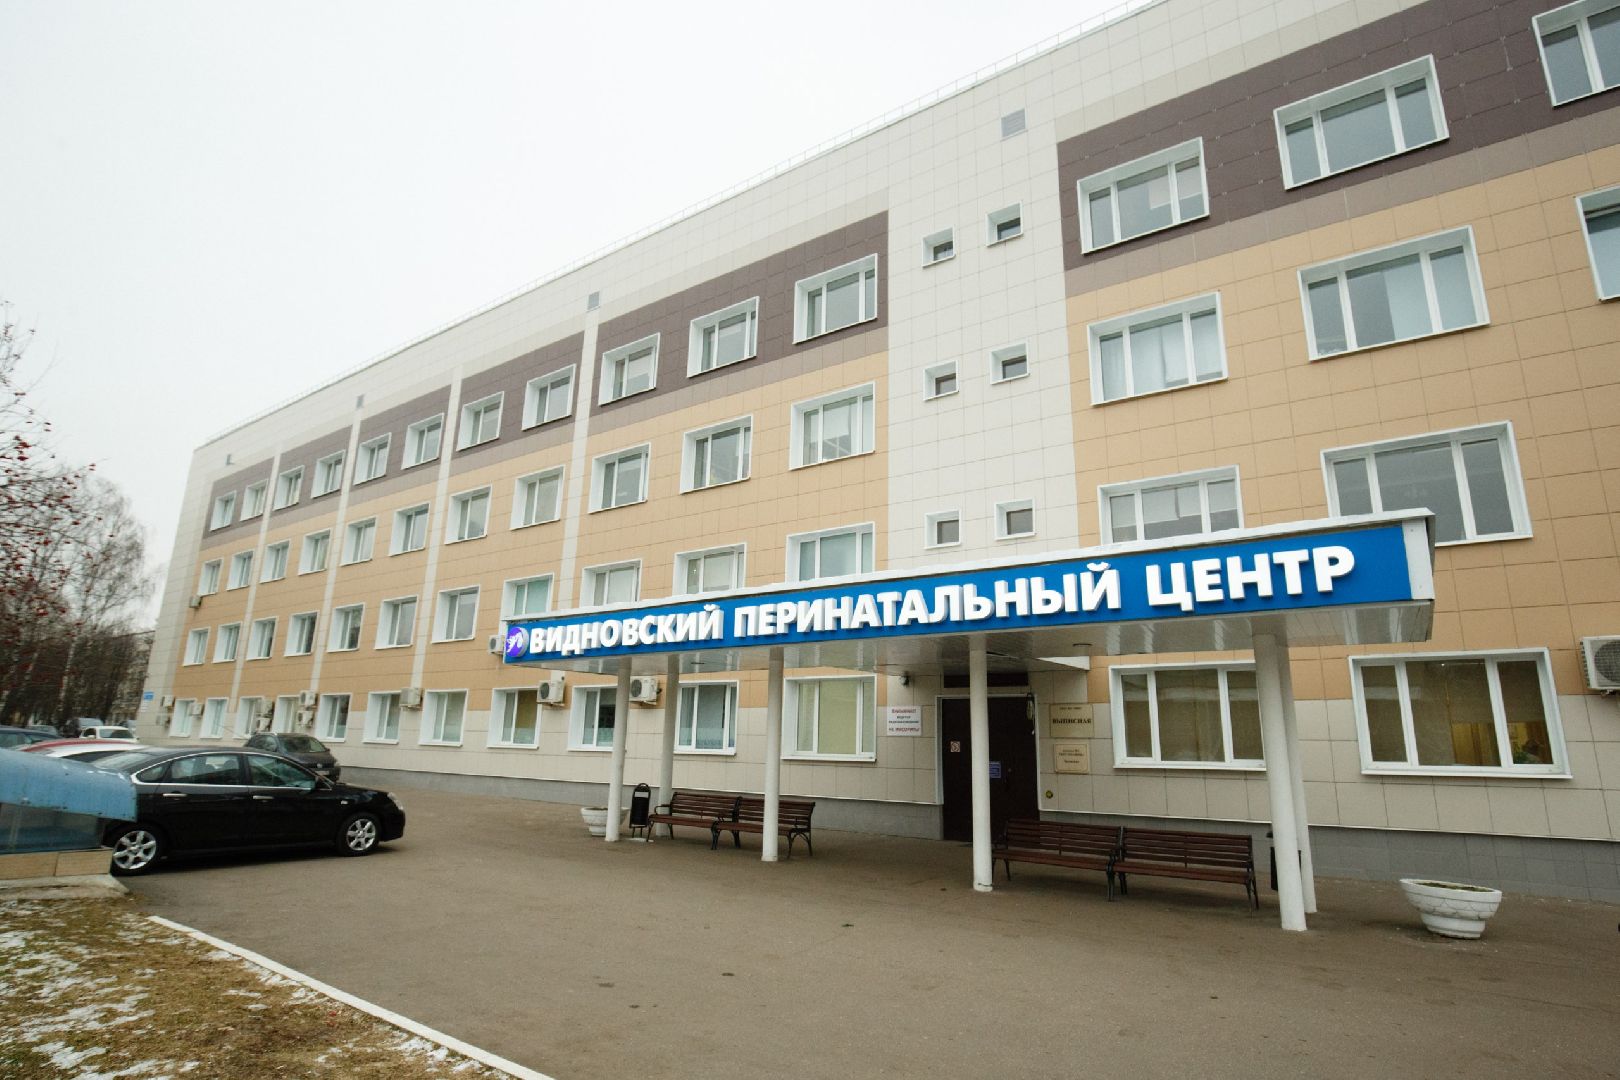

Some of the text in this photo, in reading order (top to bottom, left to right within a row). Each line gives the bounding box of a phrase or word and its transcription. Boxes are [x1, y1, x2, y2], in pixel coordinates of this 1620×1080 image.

[529, 545, 1355, 656] ВИДНОВСКИЙ ПЕРИНАТАЛЬНЫЙ ЦЕНТР
